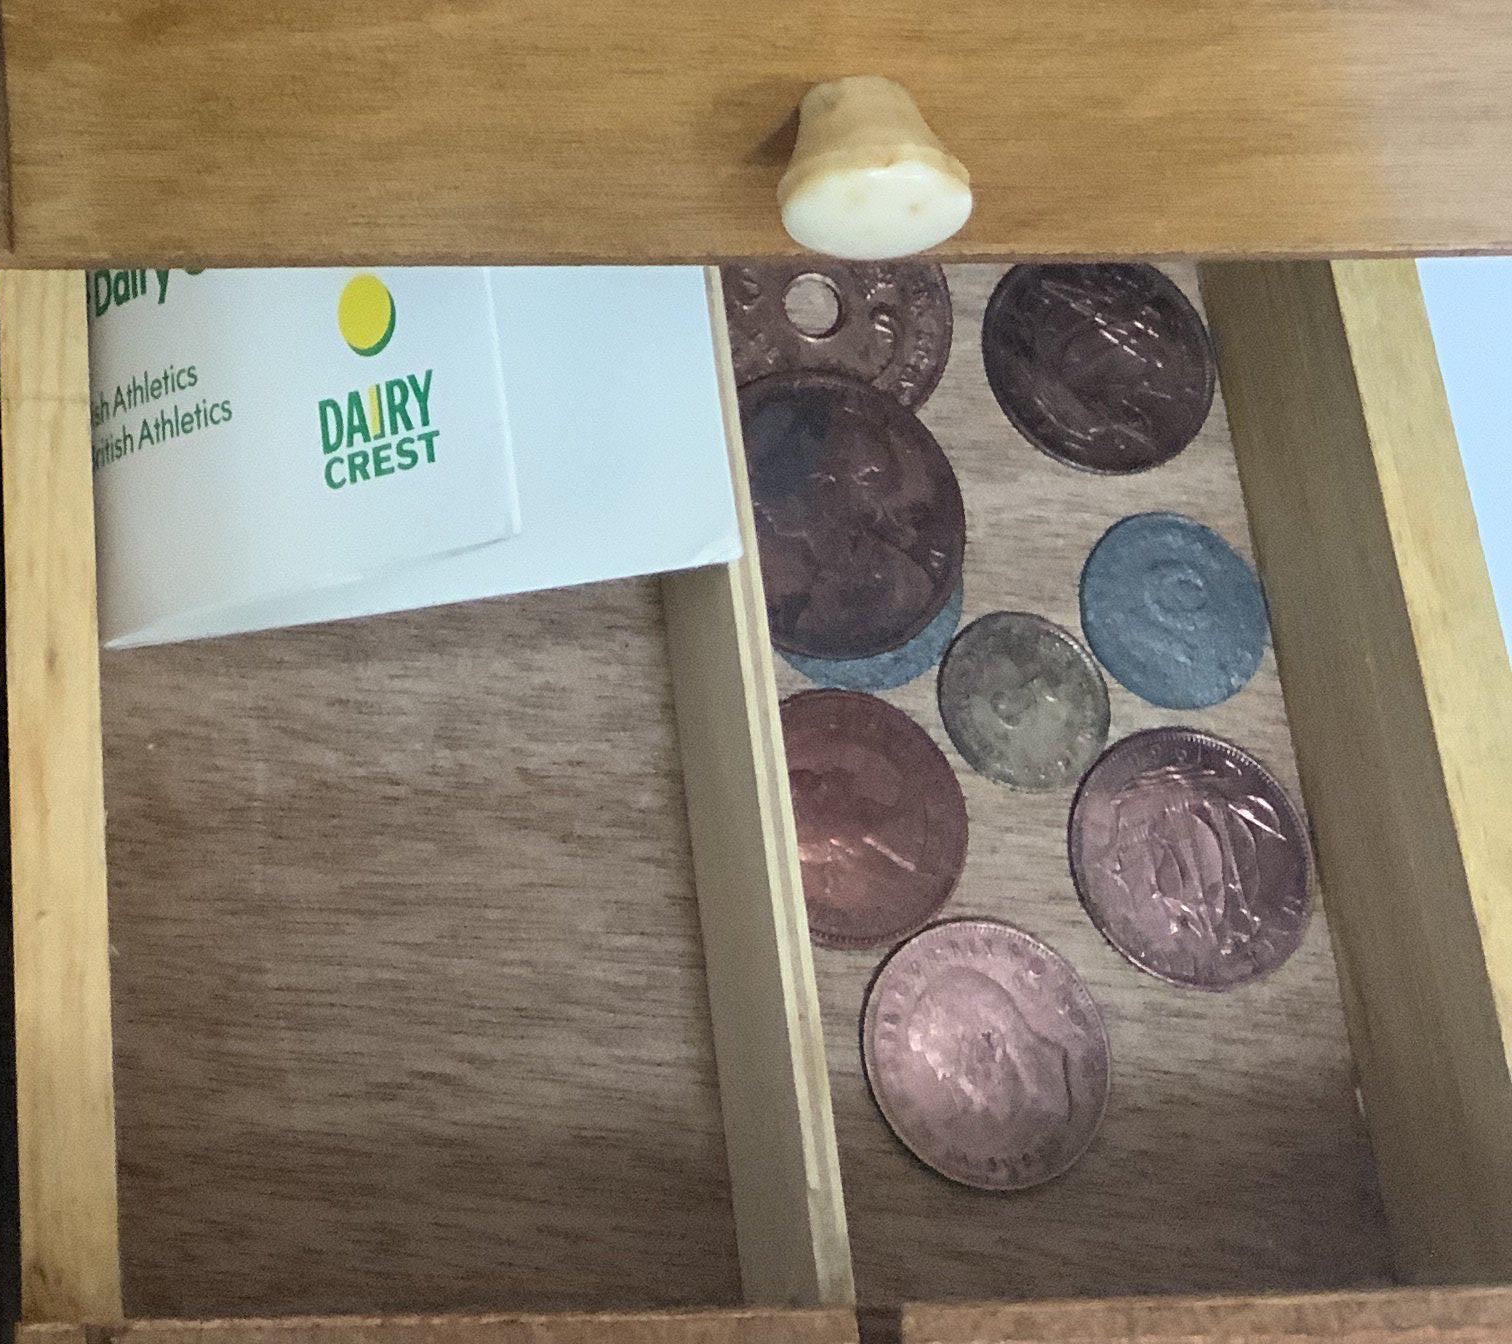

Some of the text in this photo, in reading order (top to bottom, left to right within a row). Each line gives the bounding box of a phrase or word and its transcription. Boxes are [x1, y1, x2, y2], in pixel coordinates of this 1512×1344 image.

[112, 364, 198, 418] Athletics
[318, 369, 433, 455] DAIRY
[138, 398, 233, 450] Athletics
[324, 429, 440, 490] CREST
